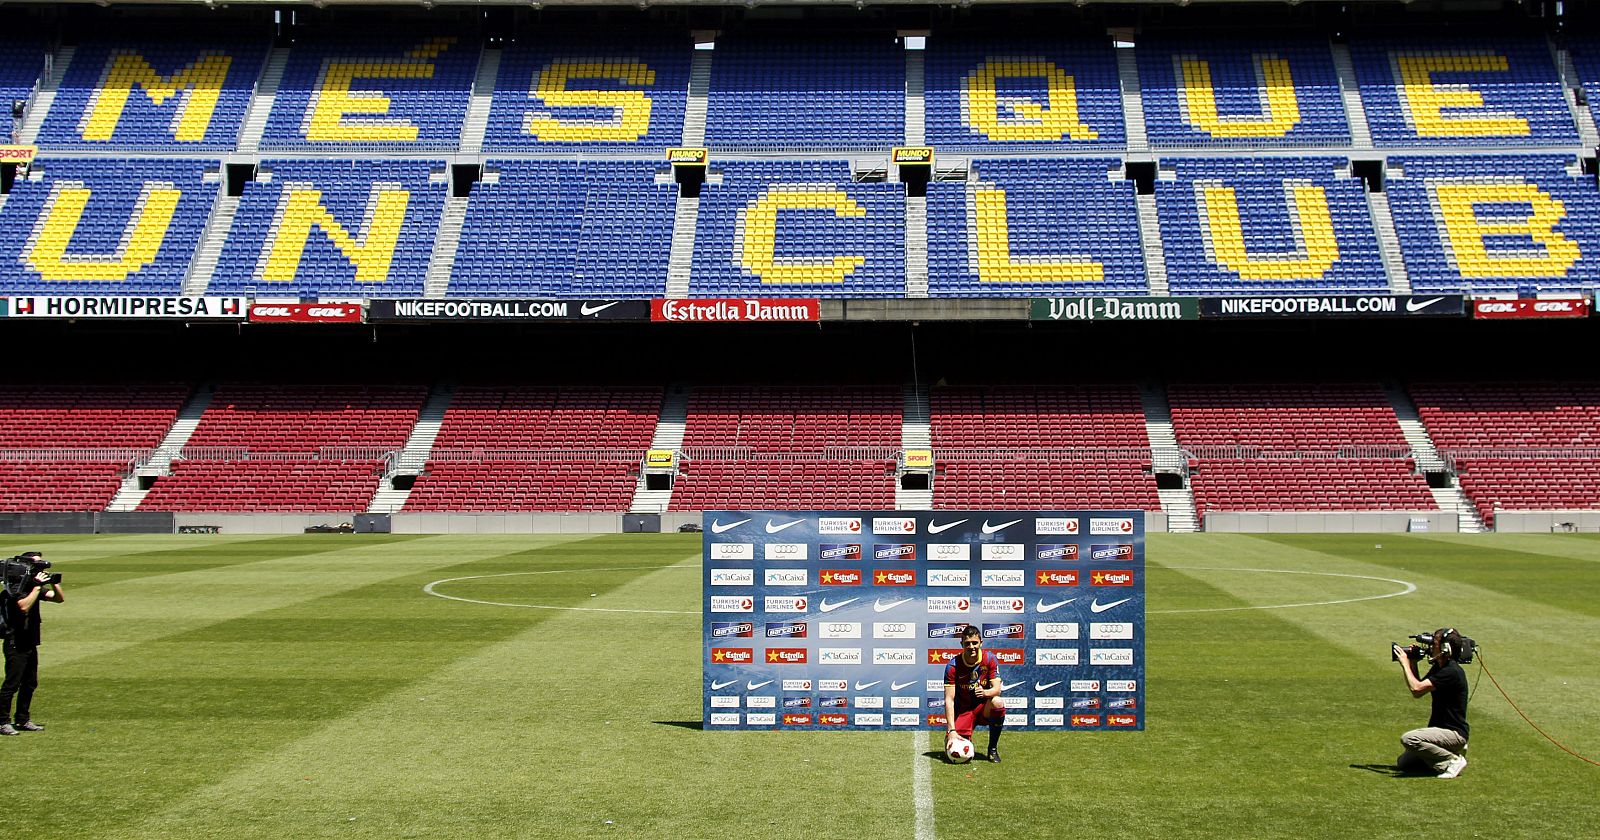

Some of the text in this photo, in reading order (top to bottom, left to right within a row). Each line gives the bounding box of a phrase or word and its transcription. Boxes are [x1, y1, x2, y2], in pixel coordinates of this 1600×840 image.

[78, 37, 1529, 142] MÉS QUE
[0, 149, 33, 158] SPORT
[672, 150, 704, 158] MUNDO
[897, 149, 930, 157] MUNDO
[20, 176, 1581, 283] UN CLUB
[47, 297, 209, 315] HORMIPRESA
[253, 307, 291, 316] GOL
[307, 307, 346, 317] GOL
[395, 302, 567, 317] NIKEFOOTBALL.COM
[662, 300, 809, 321] Estrella Damm
[1048, 297, 1182, 320] Voll-Damm
[1221, 297, 1396, 313] NIKEFOOTBALL.COM
[1478, 303, 1517, 312] GOL
[1534, 302, 1573, 311] GOL
